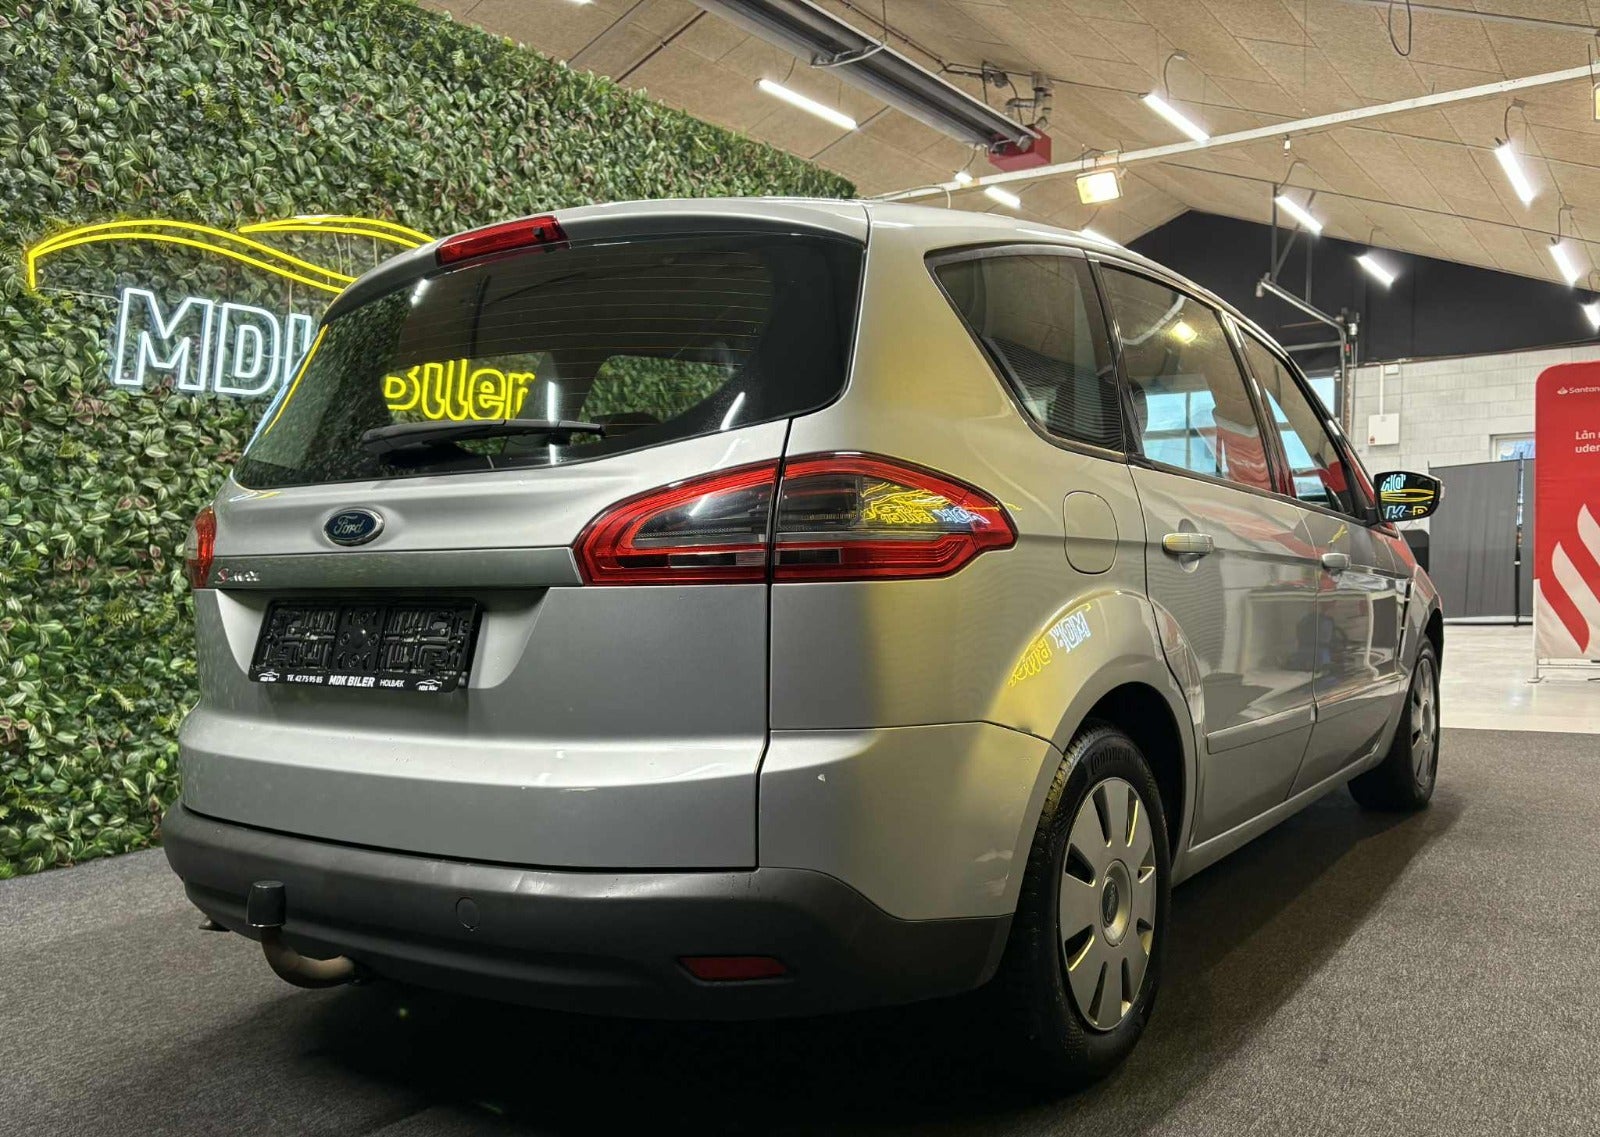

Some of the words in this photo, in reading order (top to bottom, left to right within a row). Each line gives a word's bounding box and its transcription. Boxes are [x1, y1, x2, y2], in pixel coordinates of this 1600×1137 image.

[333, 514, 366, 535] Ford
[328, 675, 347, 685] MDK
[347, 675, 376, 688] BILER
